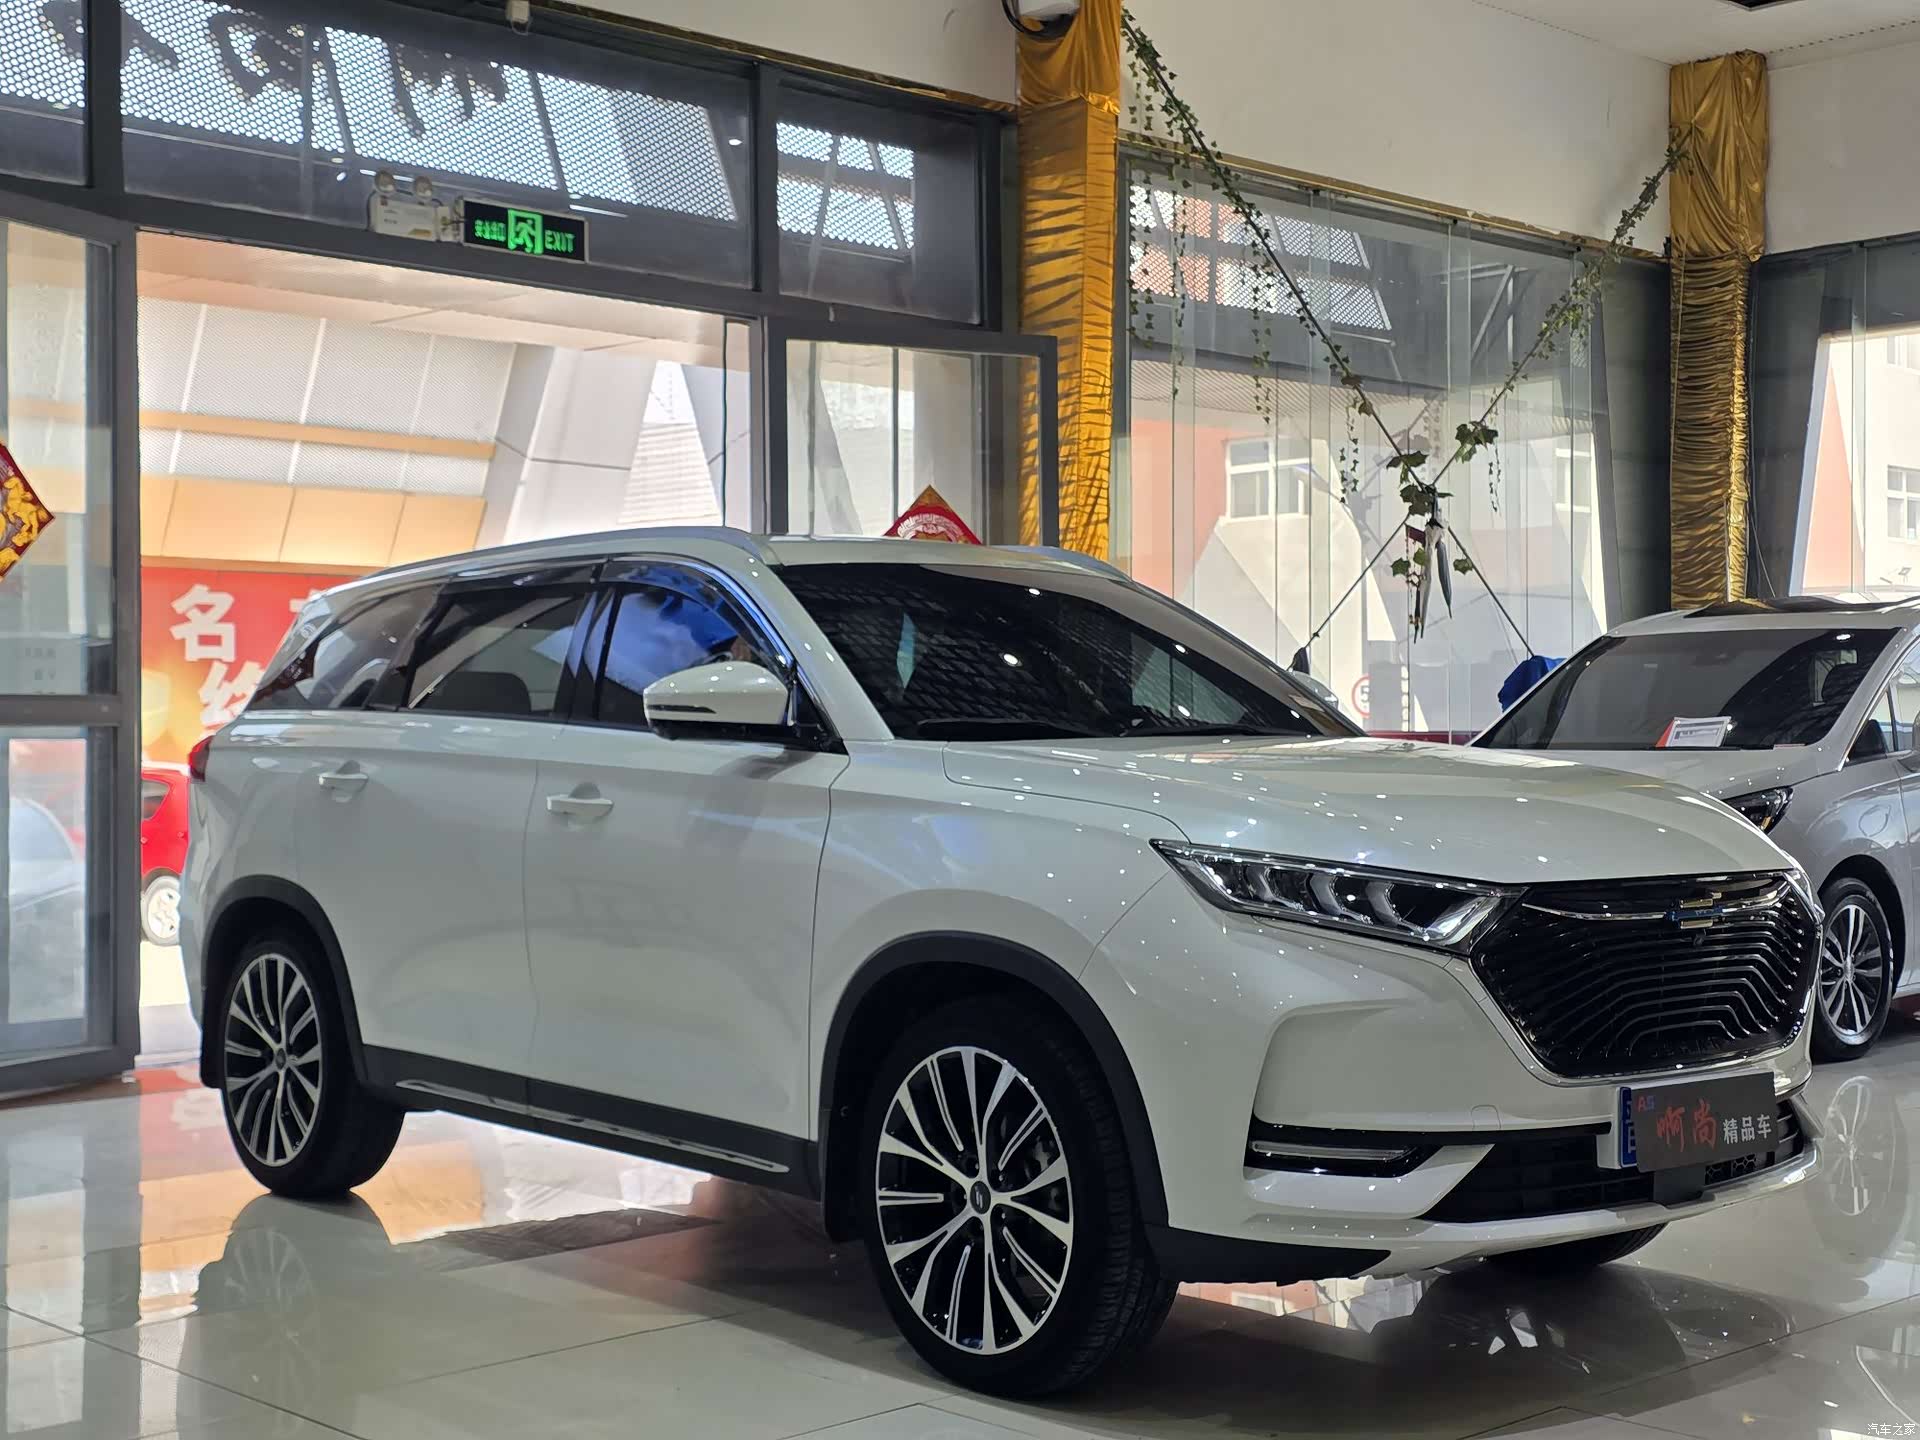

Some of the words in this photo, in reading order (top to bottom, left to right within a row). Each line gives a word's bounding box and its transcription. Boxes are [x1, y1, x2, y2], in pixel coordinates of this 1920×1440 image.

[545, 229, 574, 253] EXIT
[170, 584, 235, 663] 名
[1722, 1114, 1773, 1145] 精品车
